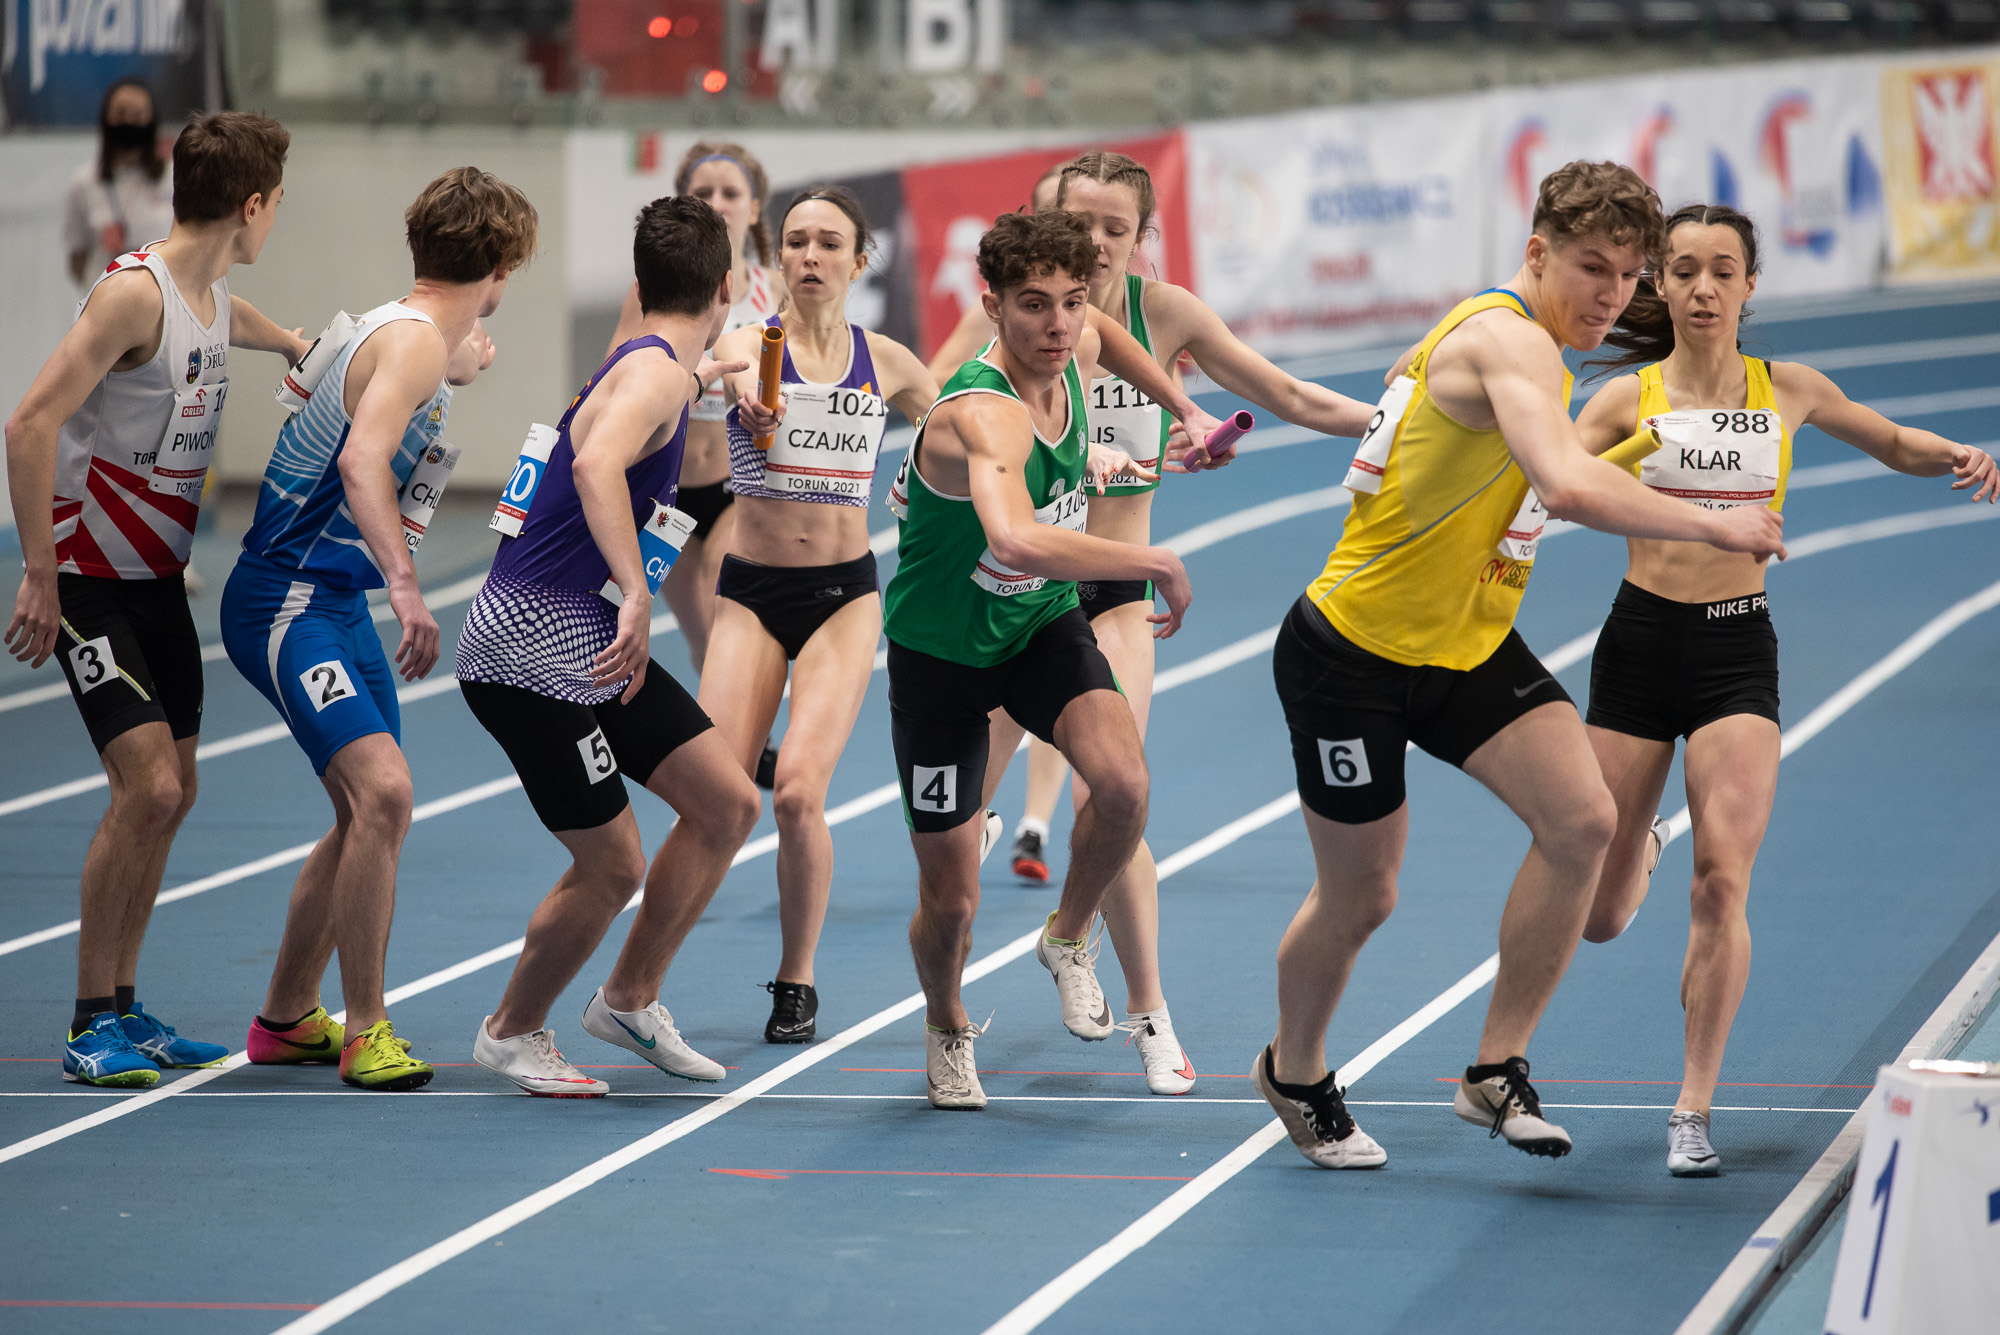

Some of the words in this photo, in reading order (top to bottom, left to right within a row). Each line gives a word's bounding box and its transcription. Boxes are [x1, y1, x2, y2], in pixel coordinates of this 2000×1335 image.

[183, 407, 204, 416] ORLEN
[827, 391, 885, 417] 1021
[1711, 412, 1770, 434] 988
[788, 428, 869, 453] CZAJKA
[1089, 426, 1115, 444] IS
[1679, 448, 1742, 471] KLAR
[787, 477, 830, 491] TORUŃ
[833, 481, 860, 493] 2021
[1110, 474, 1138, 484] 2021
[995, 578, 1035, 594] TORUŃ
[1707, 599, 1749, 620] NIKE
[78, 645, 106, 685] 3
[312, 666, 346, 705] 2
[590, 732, 613, 774] 5
[1328, 745, 1358, 784] 6
[920, 770, 949, 810] 4
